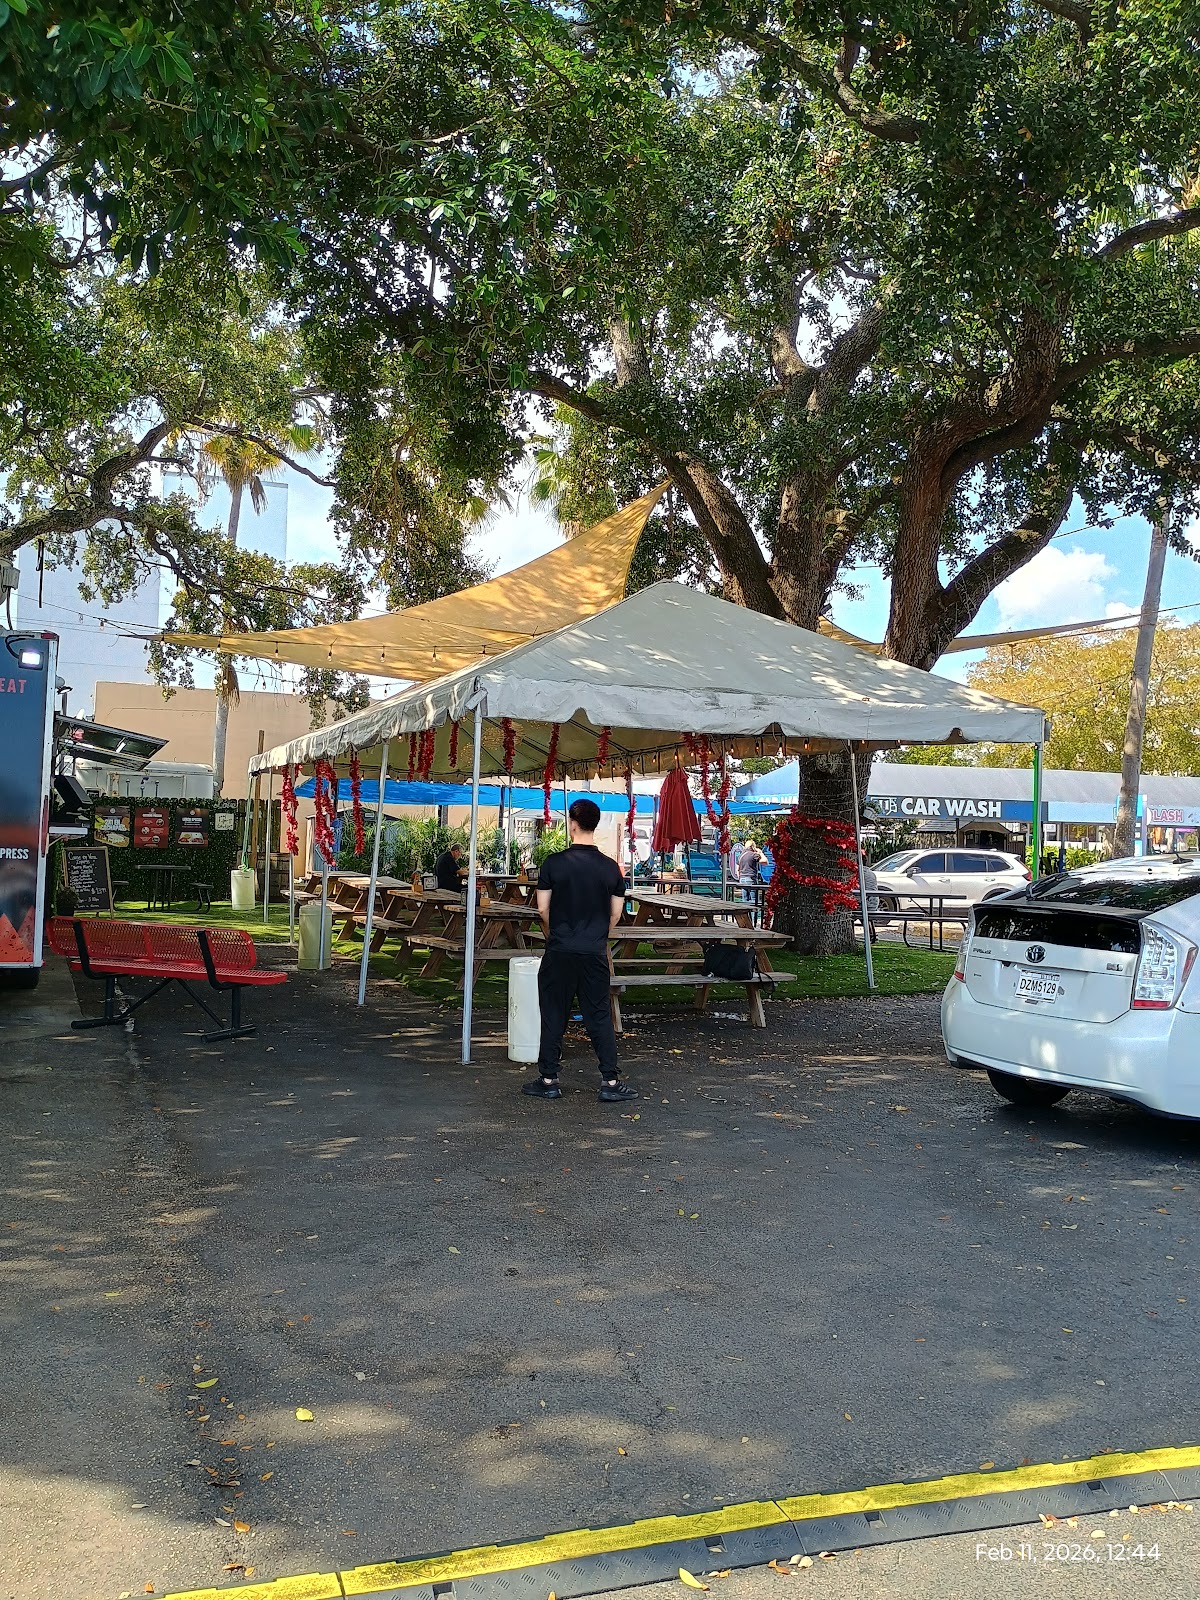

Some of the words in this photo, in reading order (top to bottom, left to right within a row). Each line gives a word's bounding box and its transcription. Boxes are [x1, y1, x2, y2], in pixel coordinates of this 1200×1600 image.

[901, 798, 941, 816] CAR
[944, 799, 1002, 818] WASH
[1151, 808, 1184, 822] LASH
[1020, 978, 1057, 994] DZM5129
